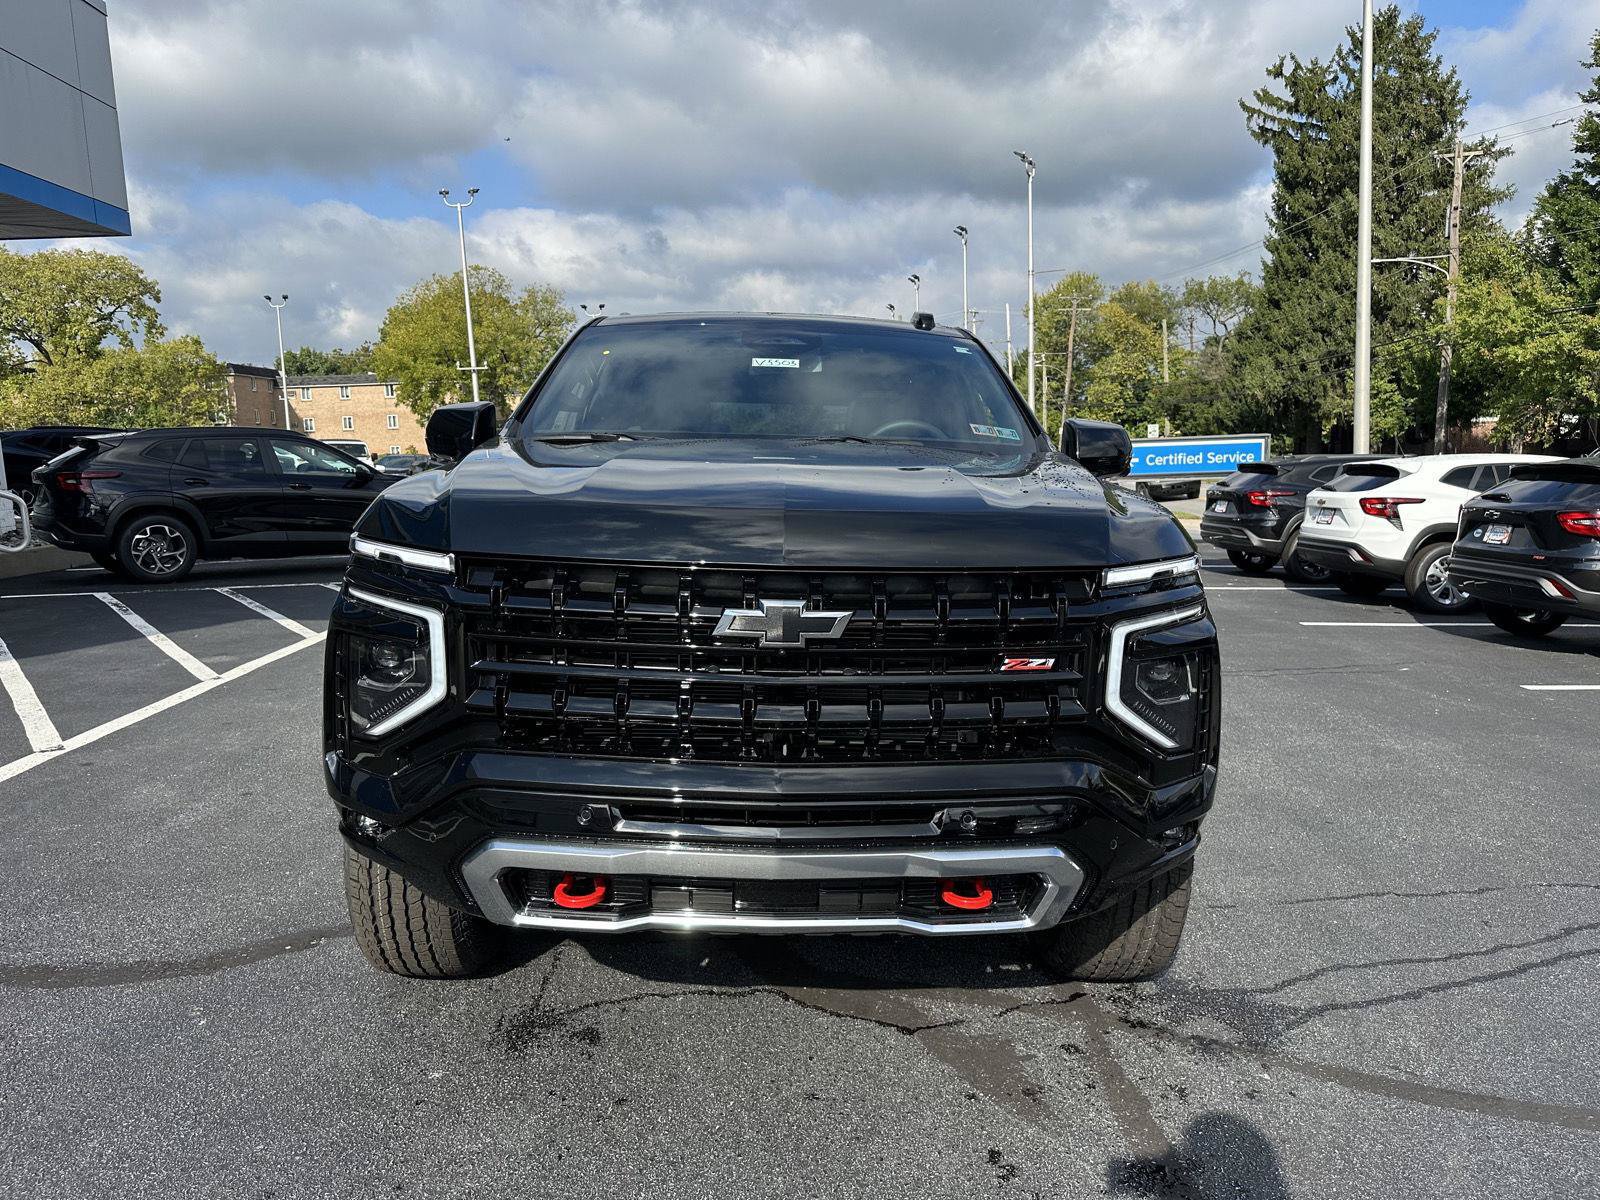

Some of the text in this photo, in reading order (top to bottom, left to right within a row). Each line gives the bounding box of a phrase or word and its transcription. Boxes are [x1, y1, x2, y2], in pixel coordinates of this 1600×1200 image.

[1145, 451, 1255, 466] Certified Service
[1000, 658, 1056, 671] Z71
